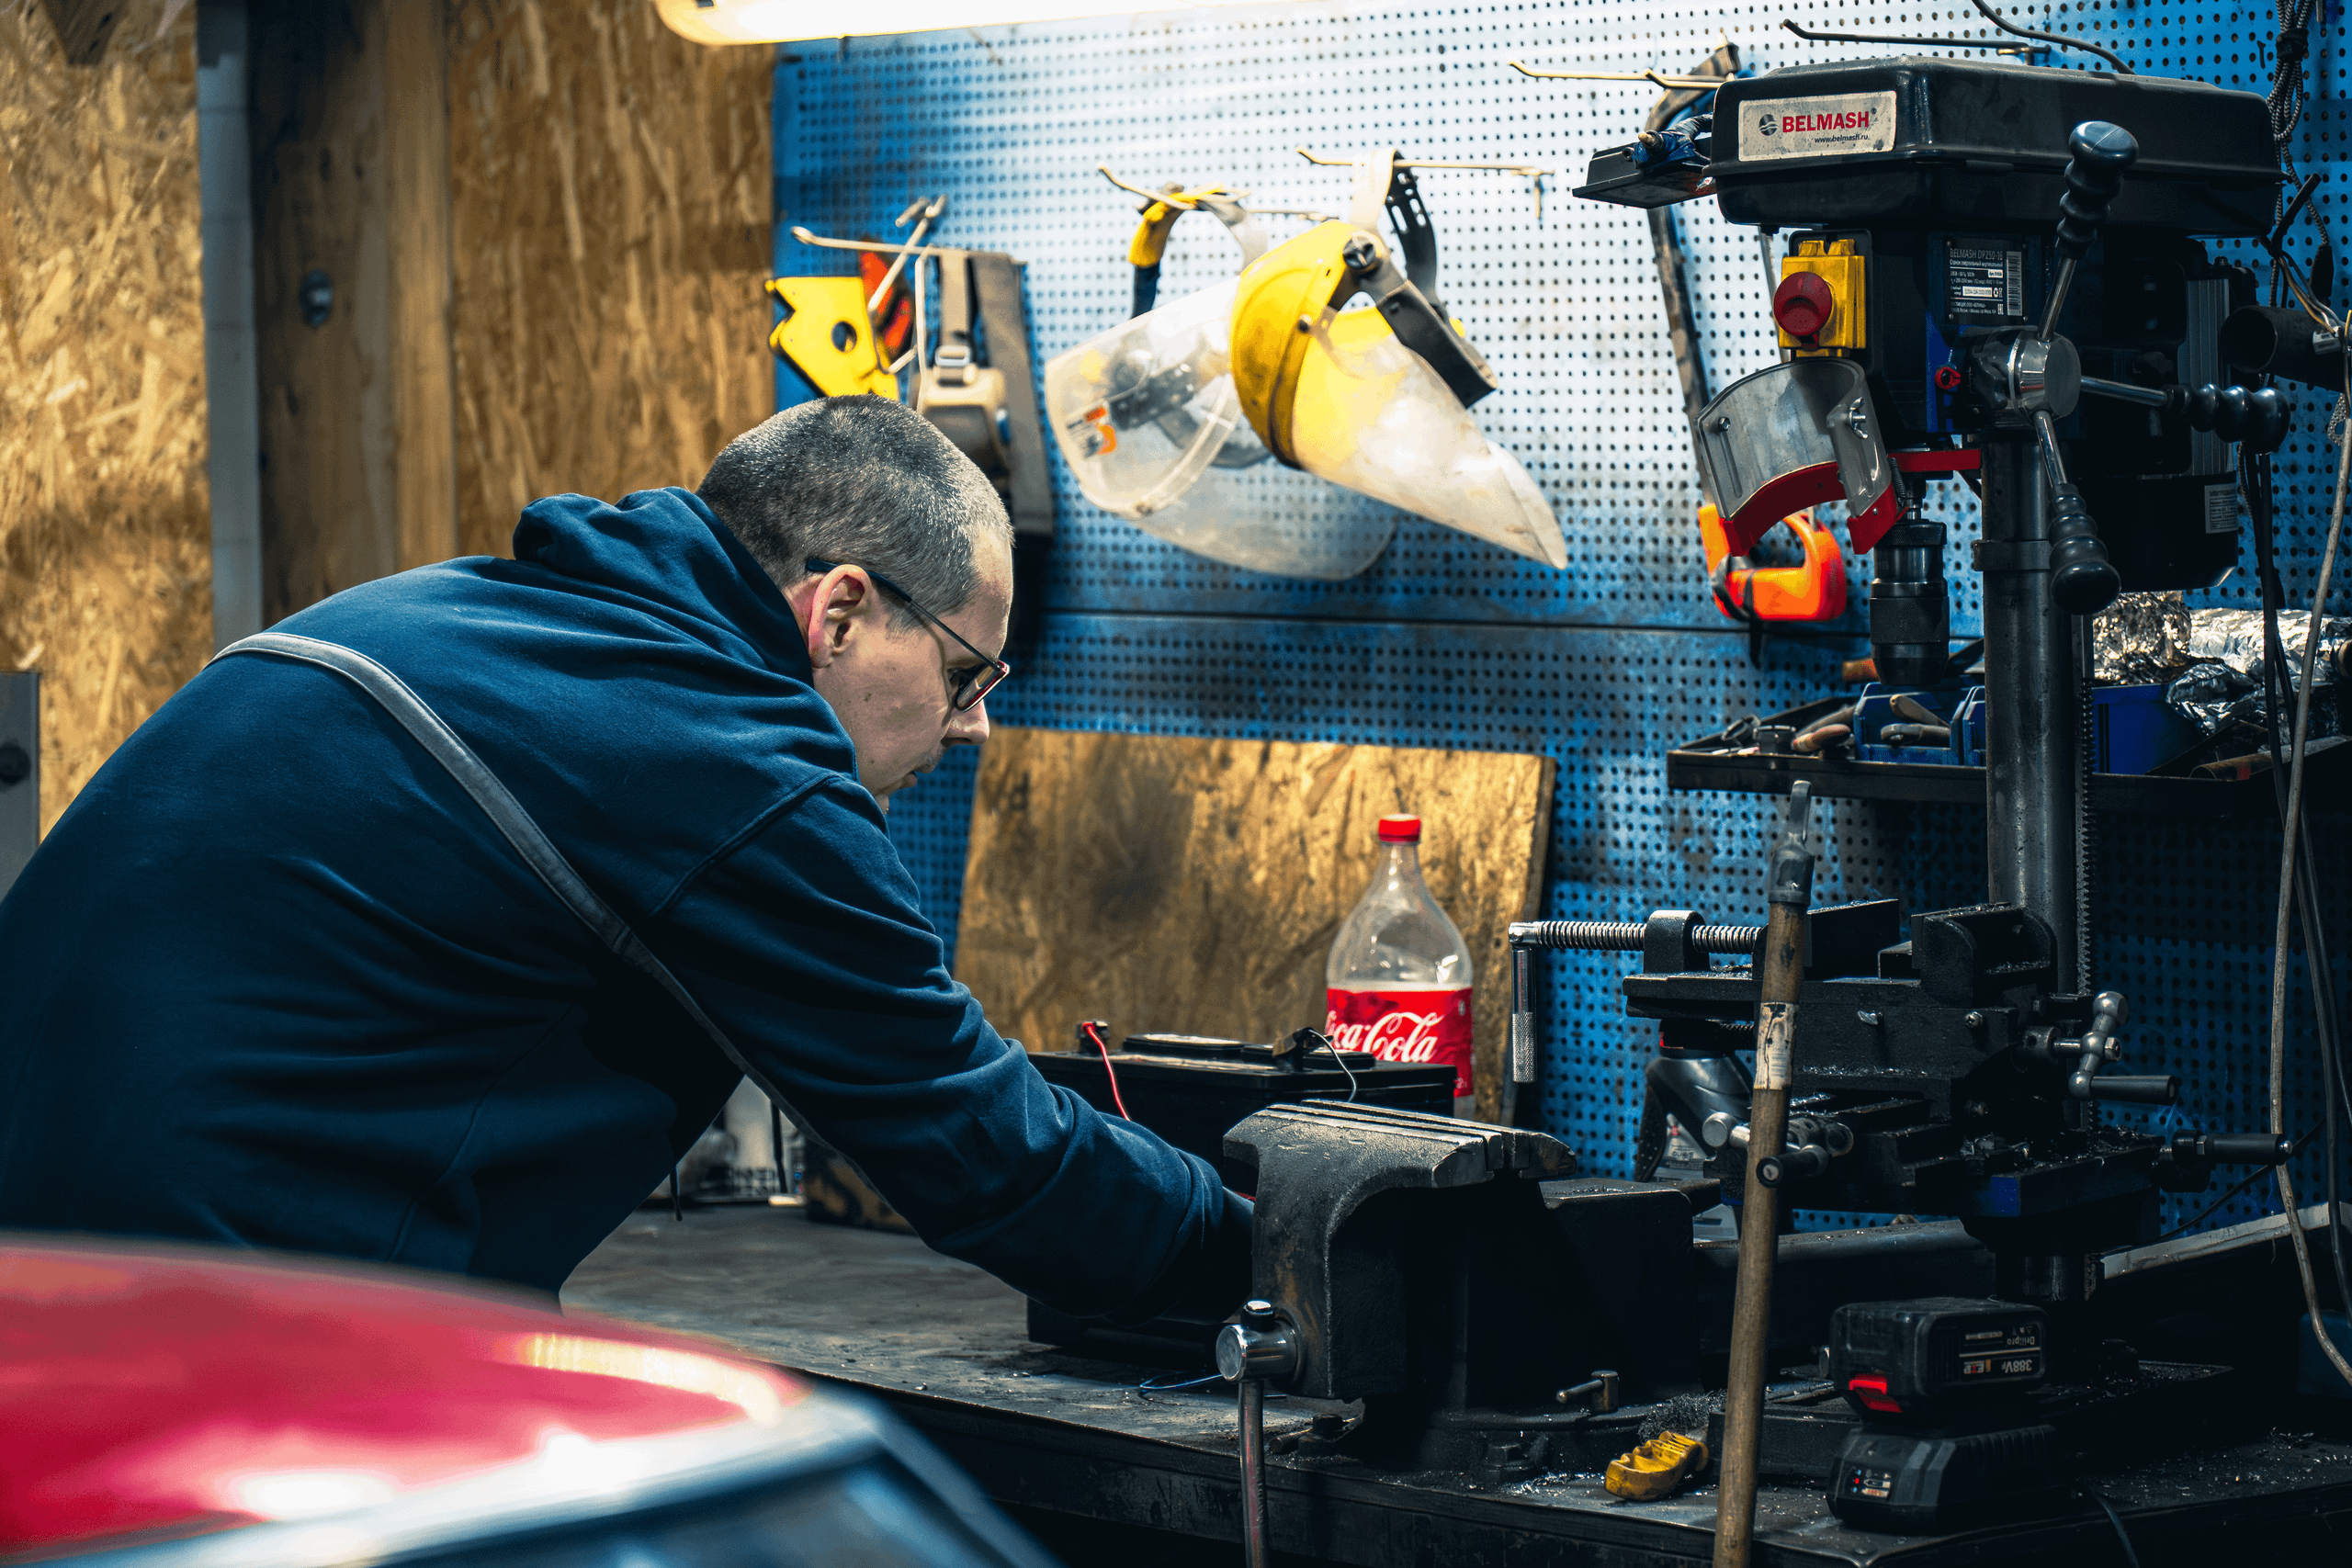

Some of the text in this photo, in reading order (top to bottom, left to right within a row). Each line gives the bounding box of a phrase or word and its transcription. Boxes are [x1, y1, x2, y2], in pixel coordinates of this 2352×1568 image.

[1782, 111, 1870, 133] BELMASH
[1815, 133, 1869, 143] www.belmash.ru
[1950, 248, 1976, 259] BELMASH
